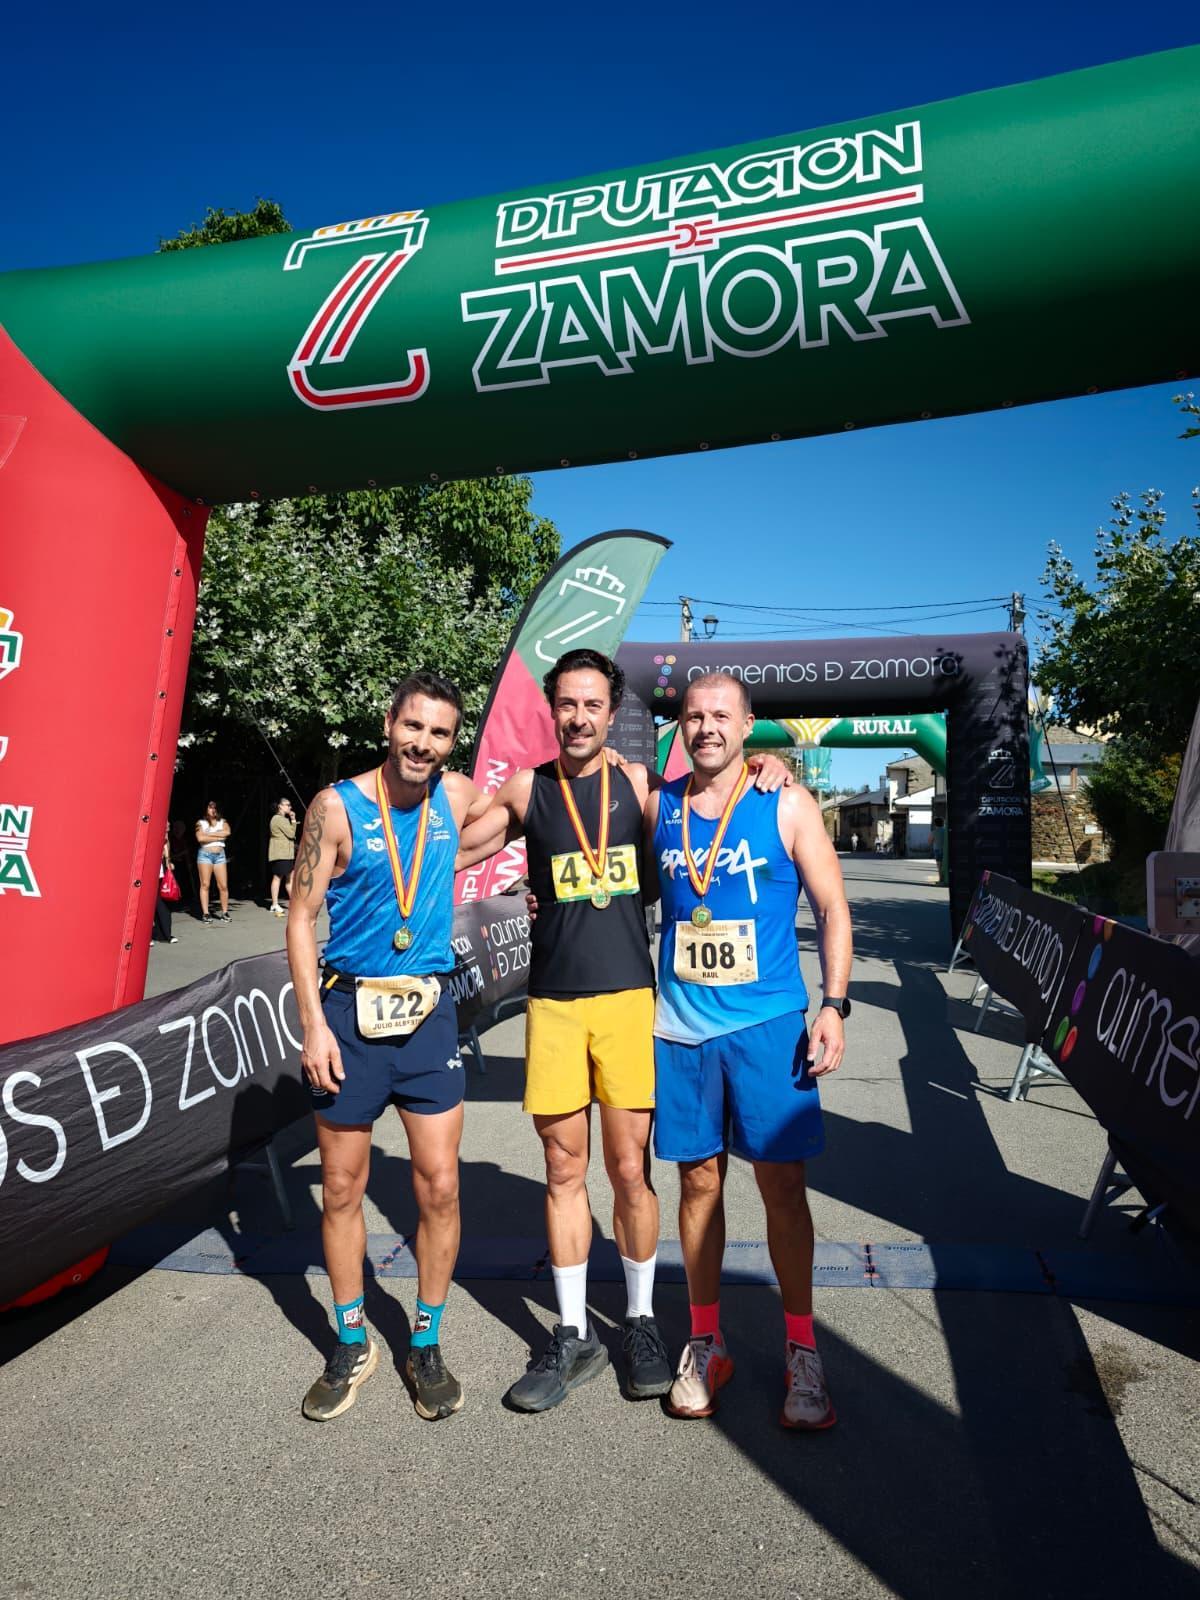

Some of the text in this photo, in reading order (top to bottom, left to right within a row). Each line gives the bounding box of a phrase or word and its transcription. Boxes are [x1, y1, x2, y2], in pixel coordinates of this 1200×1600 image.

[461, 217, 971, 392] ZAMORA
[849, 656, 959, 680] zamora
[852, 719, 917, 736] RURAL
[978, 806, 1024, 817] ZAMORA
[559, 850, 627, 888] 45
[685, 941, 736, 970] 108
[448, 964, 485, 1005] AMORA
[702, 971, 720, 979] RAUL
[370, 990, 424, 1021] 122
[372, 1021, 393, 1031] JULIO
